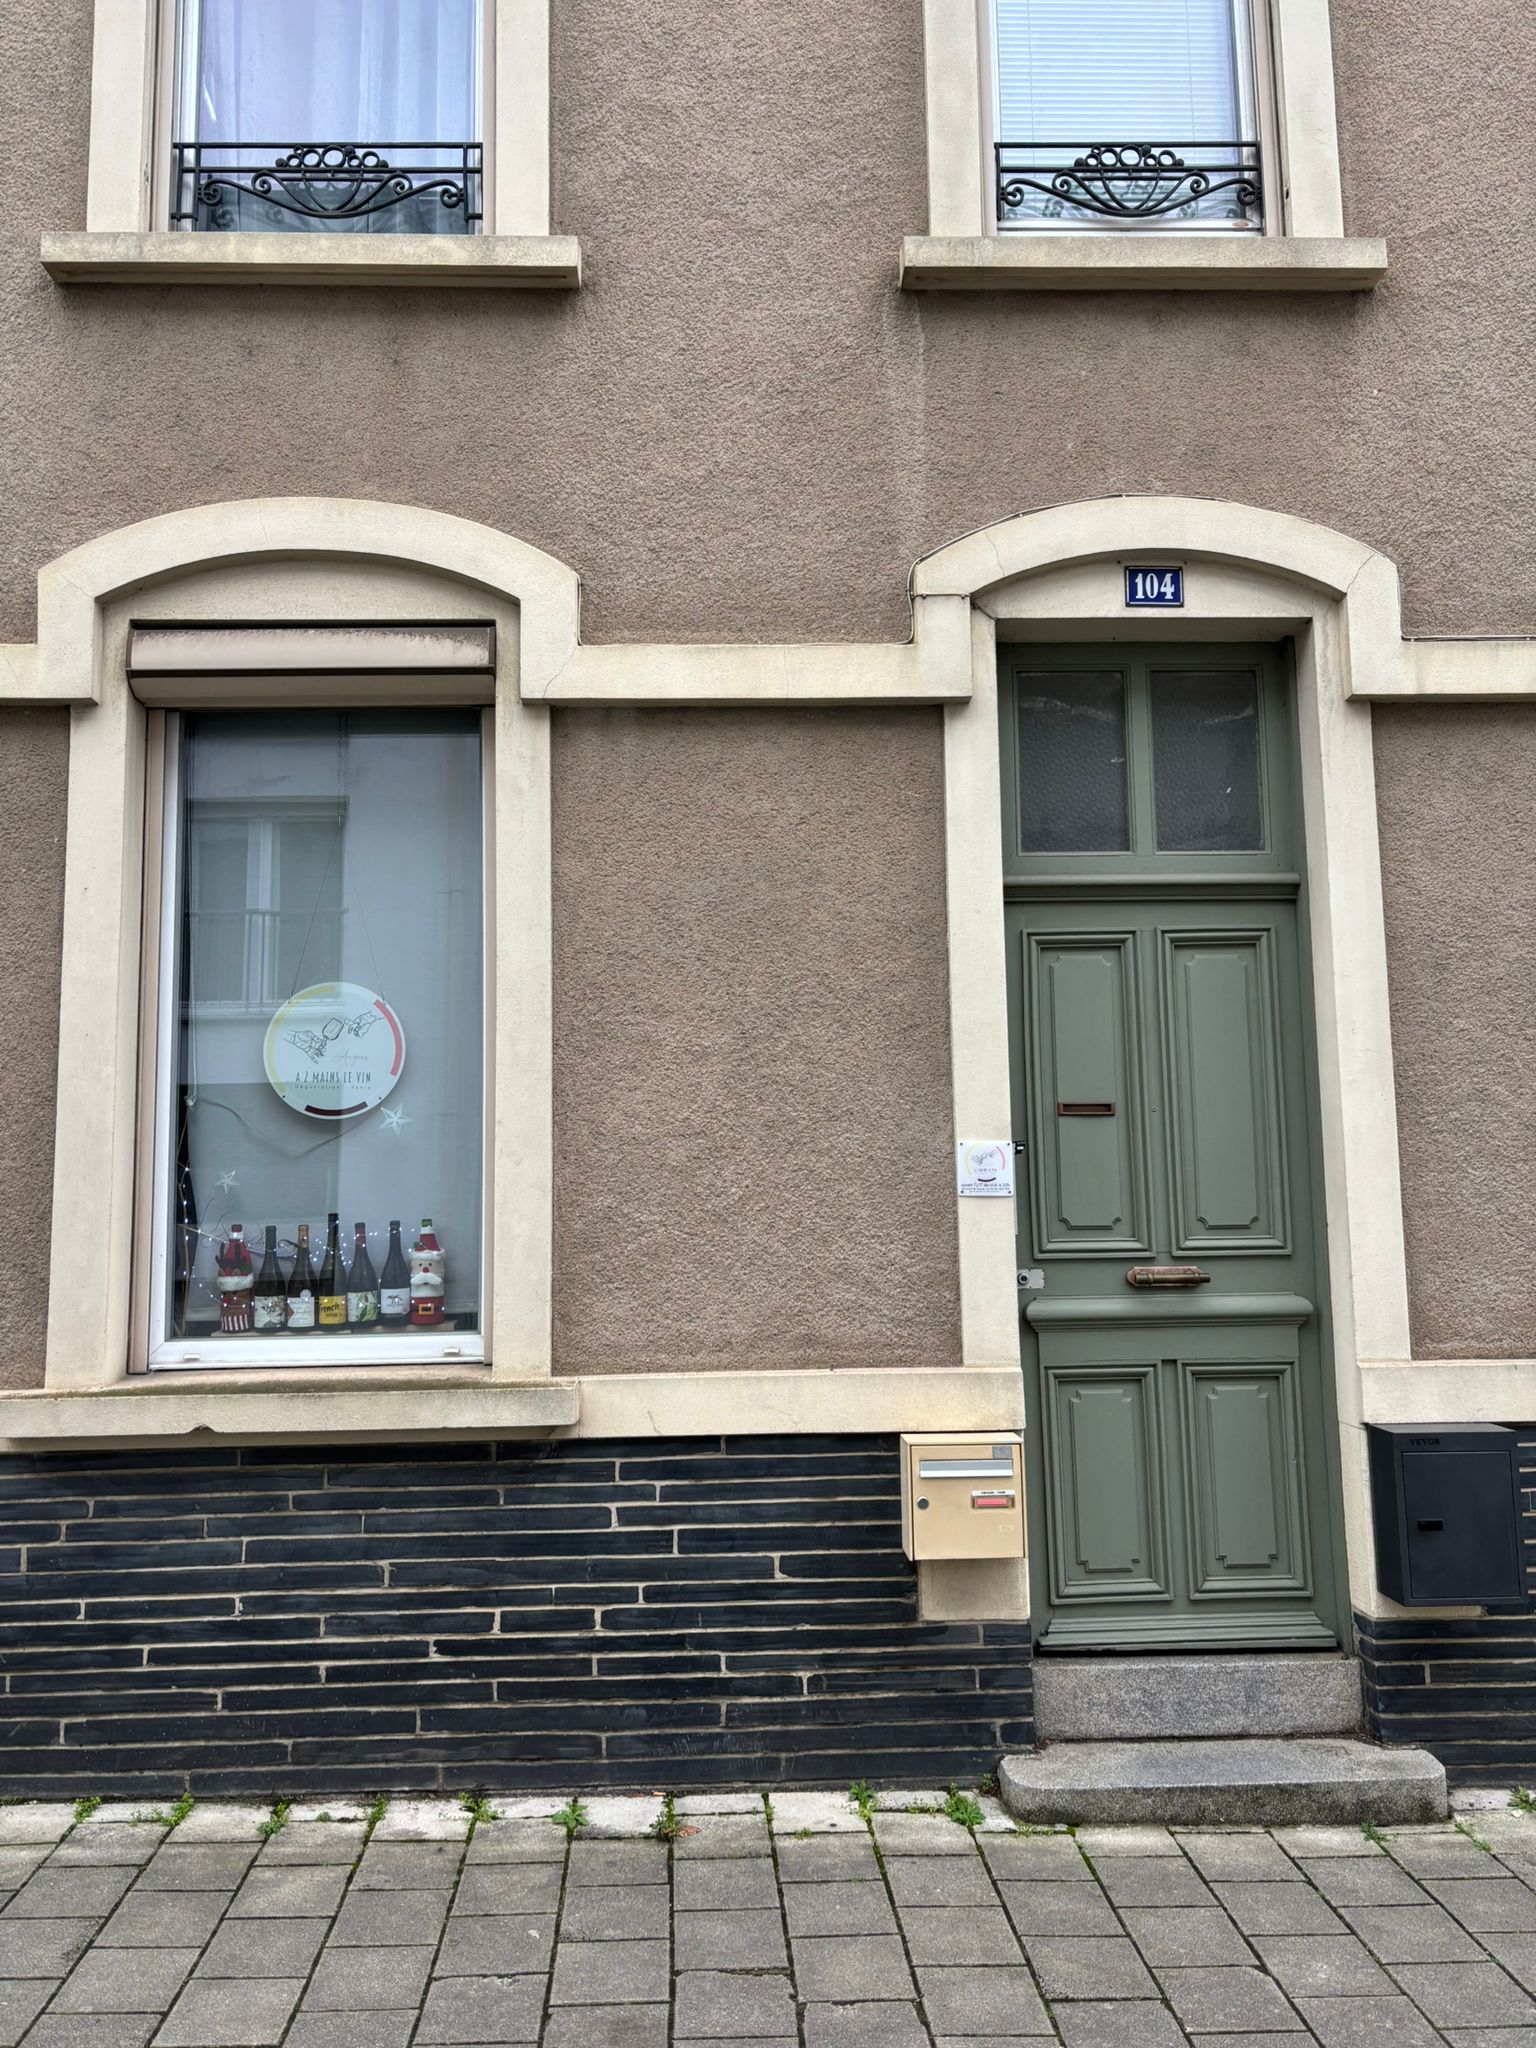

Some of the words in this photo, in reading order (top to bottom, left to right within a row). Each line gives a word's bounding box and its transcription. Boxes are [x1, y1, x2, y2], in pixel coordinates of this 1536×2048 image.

[1135, 573, 1175, 599] 104
[295, 1072, 301, 1082] A
[303, 1071, 309, 1083] 2
[312, 1072, 340, 1083] MAINS
[343, 1072, 352, 1083] LE
[356, 1072, 371, 1083] VIN
[1409, 1438, 1440, 1446] VEVOR
